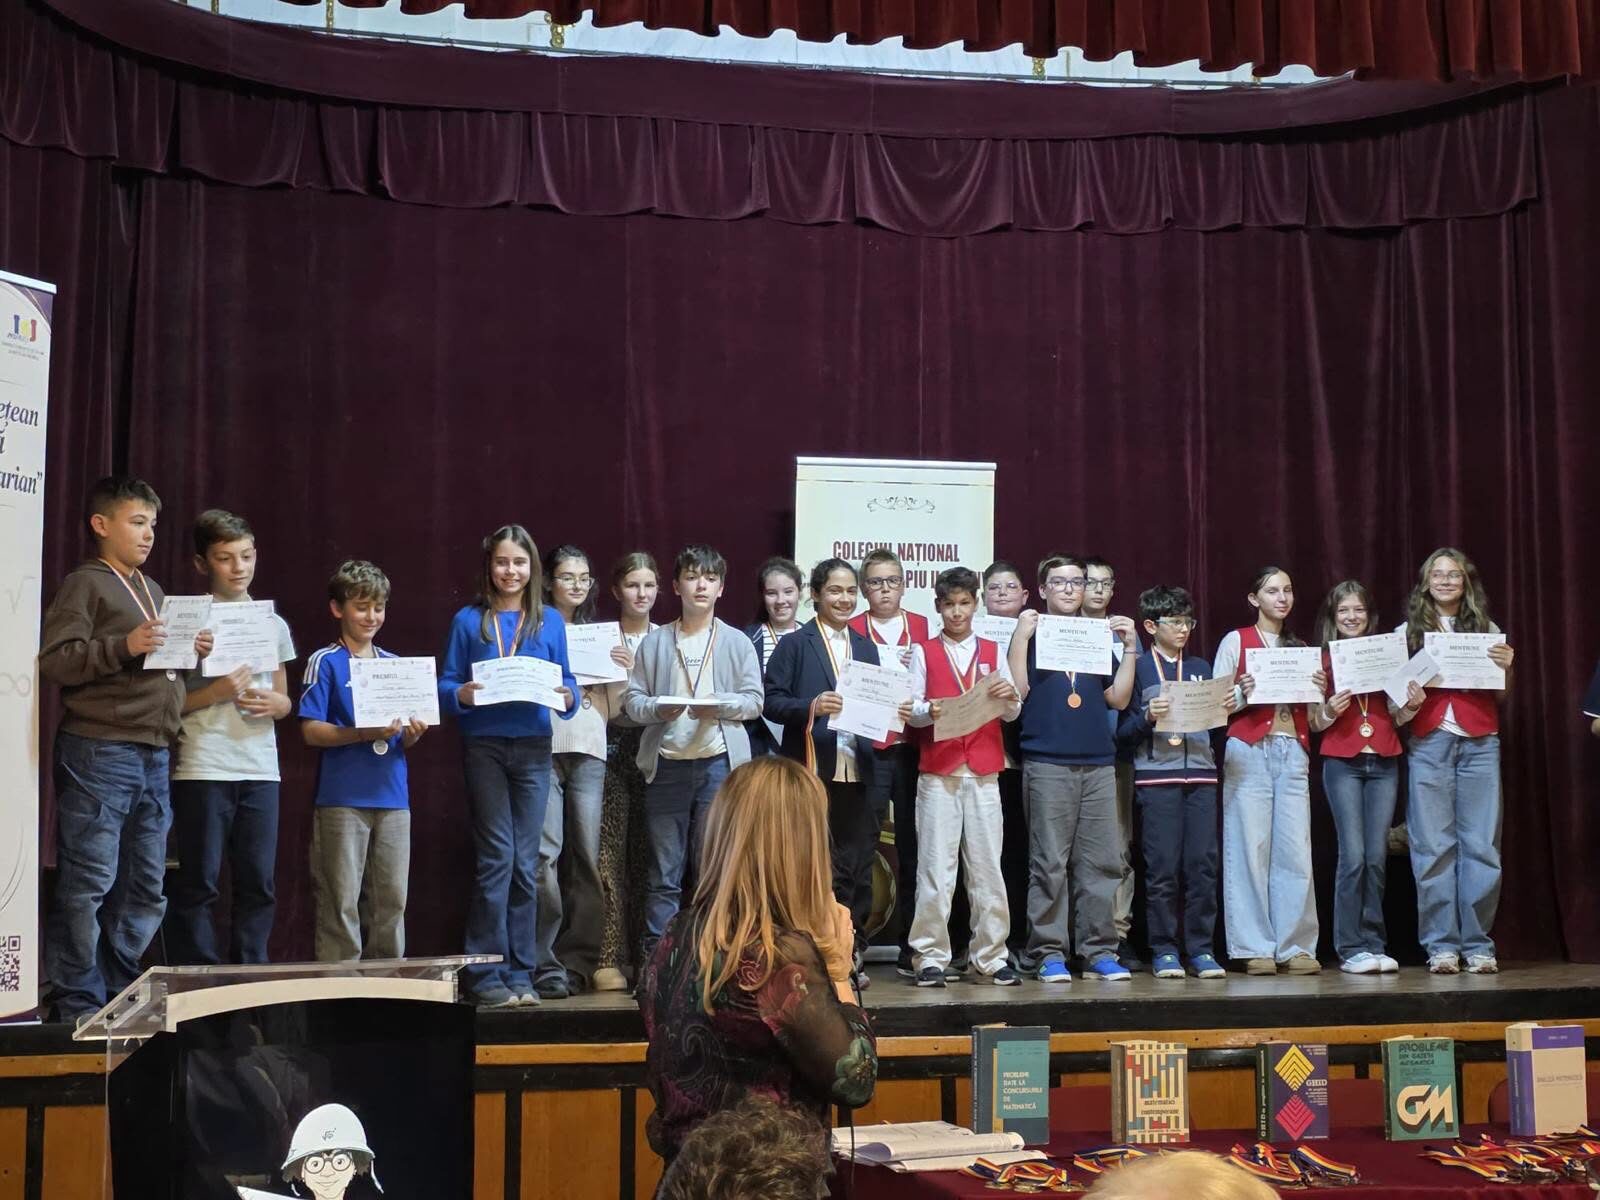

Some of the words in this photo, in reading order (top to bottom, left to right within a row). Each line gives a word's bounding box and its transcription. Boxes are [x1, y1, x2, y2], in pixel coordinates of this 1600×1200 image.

[898, 543, 960, 566] NAȚIONAL
[904, 570, 927, 589] PIU
[1399, 1042, 1450, 1053] PROBLEME
[1306, 1079, 1328, 1087] GHID
